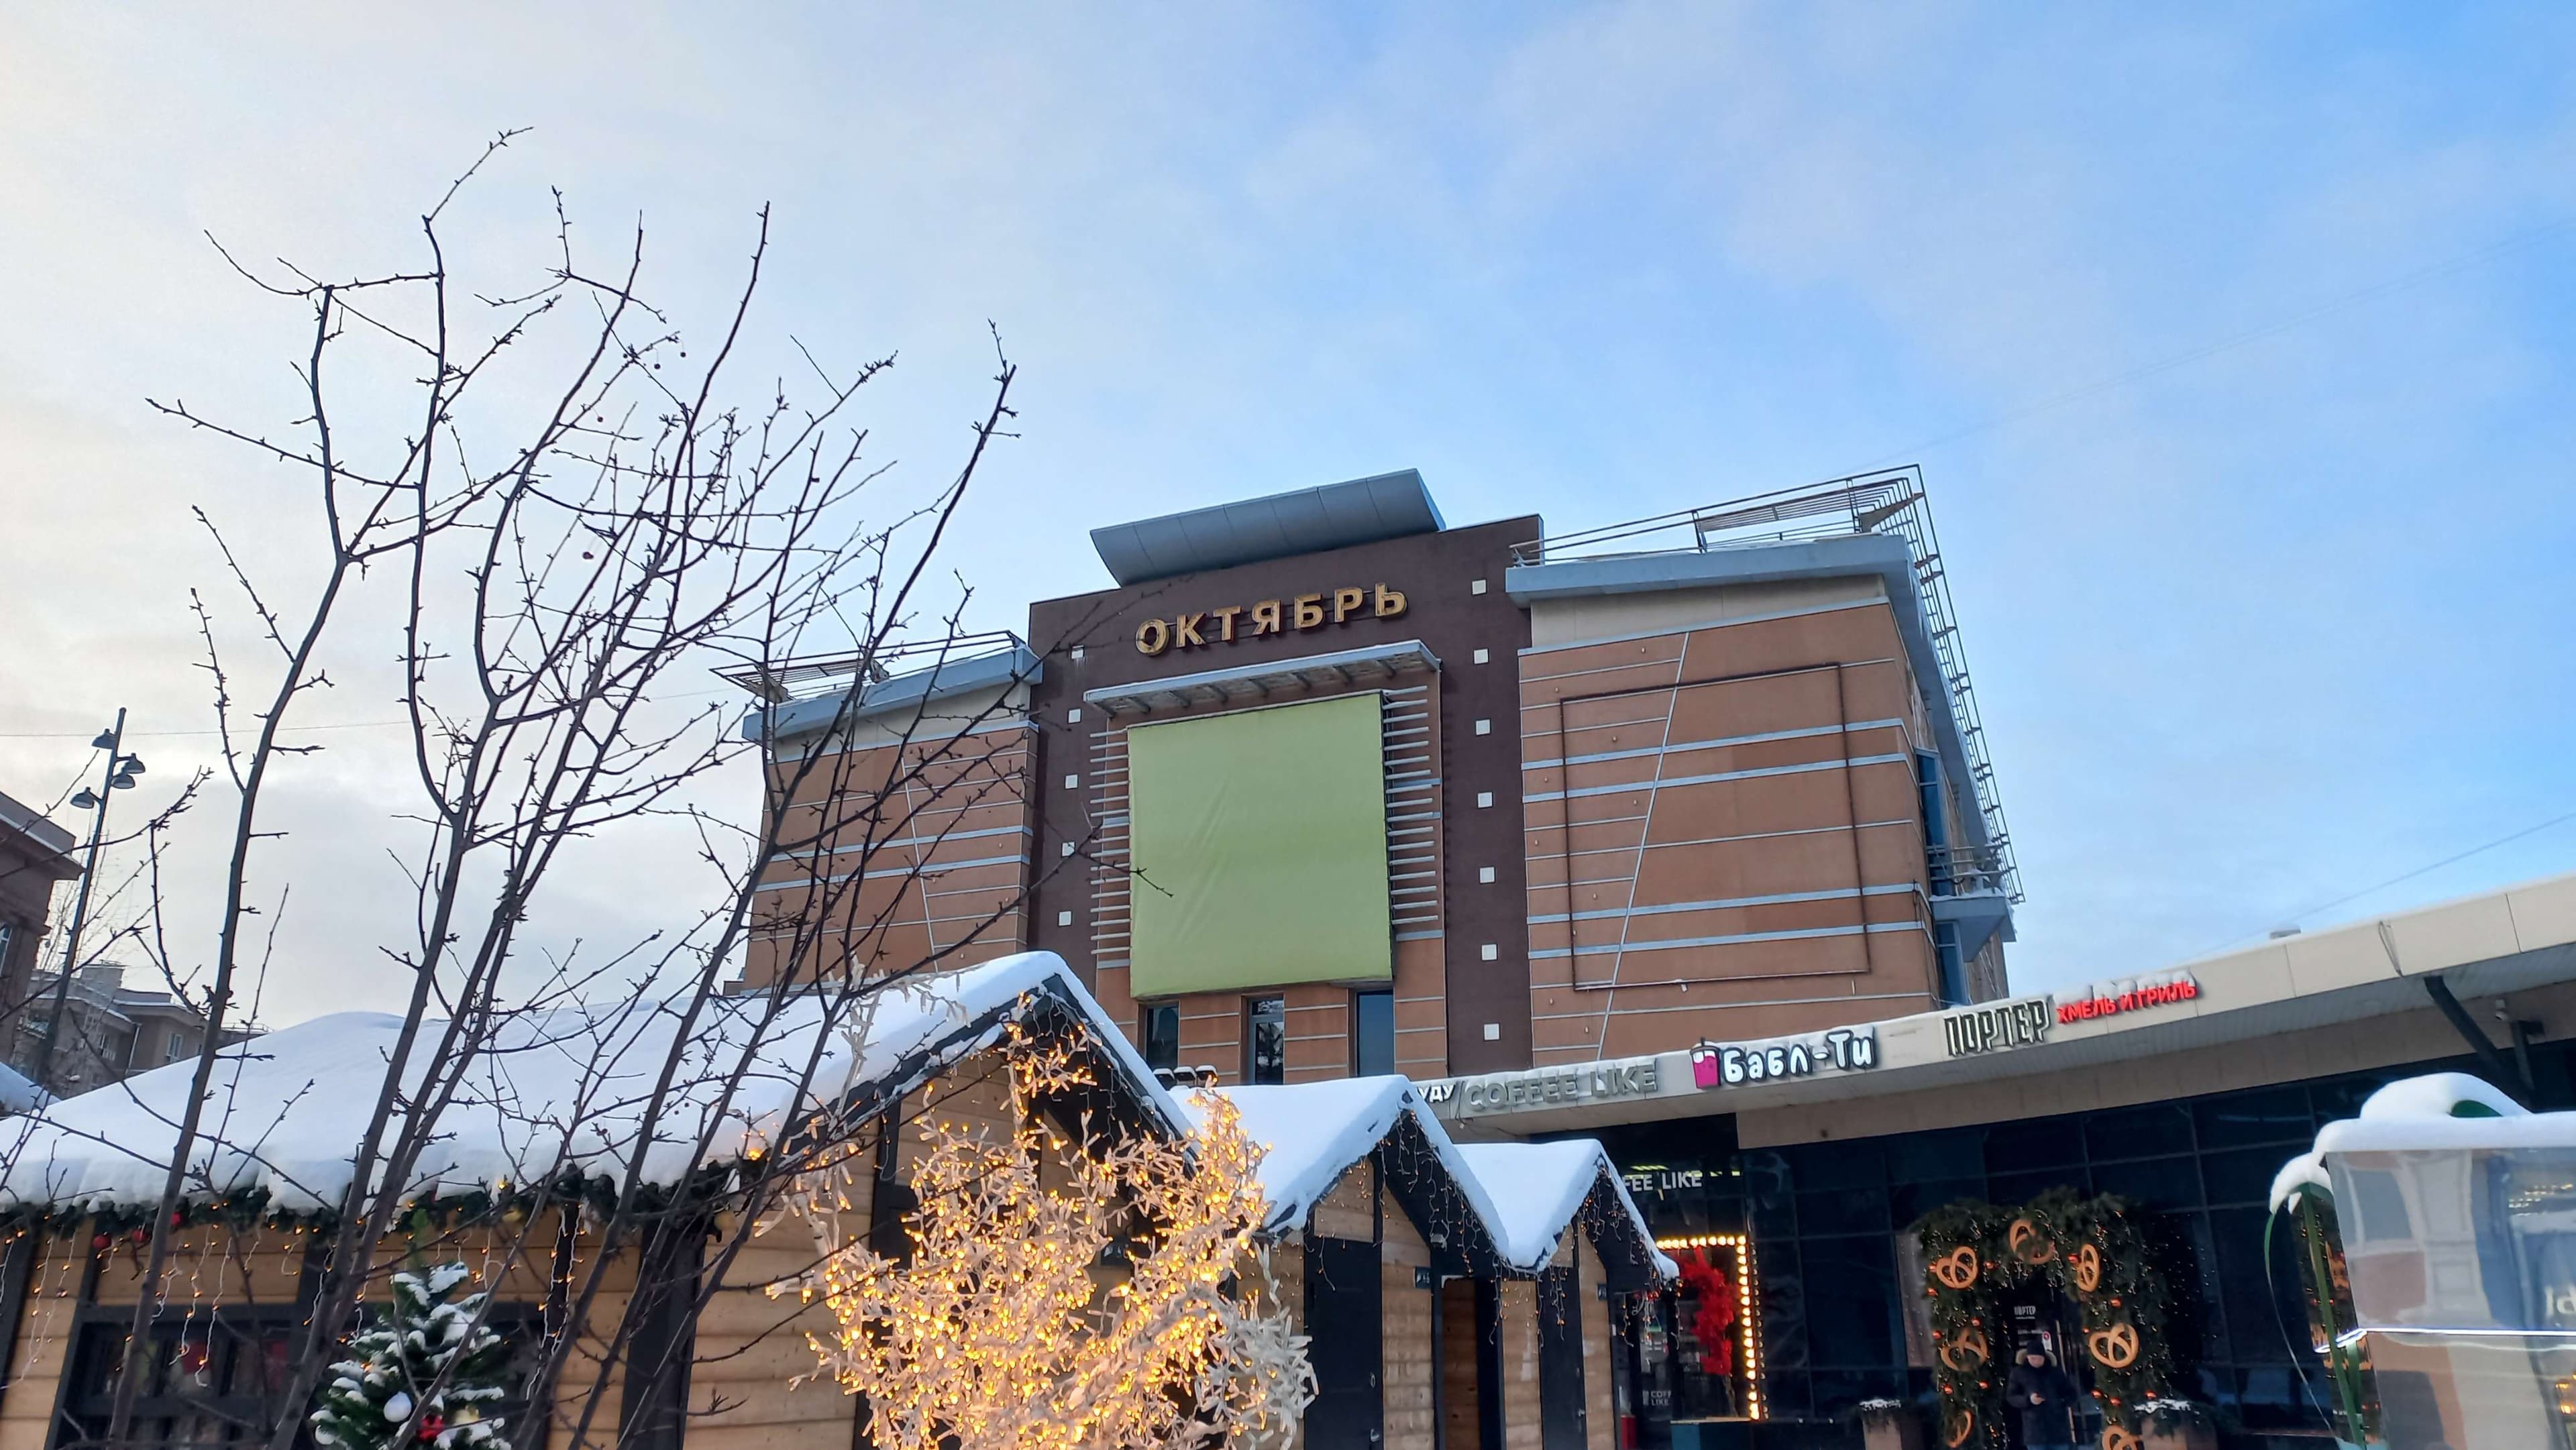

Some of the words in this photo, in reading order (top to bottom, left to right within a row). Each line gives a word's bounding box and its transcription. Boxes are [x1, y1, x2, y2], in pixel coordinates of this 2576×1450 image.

[1135, 581, 1408, 656] ОКТЯБРЬ
[1944, 999, 2051, 1057] ПОРТЕР
[2056, 995, 2117, 1025] ХМЕЛЬ
[2119, 991, 2136, 1011] И
[2137, 981, 2198, 1009] ГРИЛЬ
[1721, 1029, 1878, 1084] Бабл-Ти
[1463, 1073, 1578, 1111] COFFEE
[1589, 1062, 1658, 1098] LIKE
[1662, 1170, 1703, 1190] LIKE
